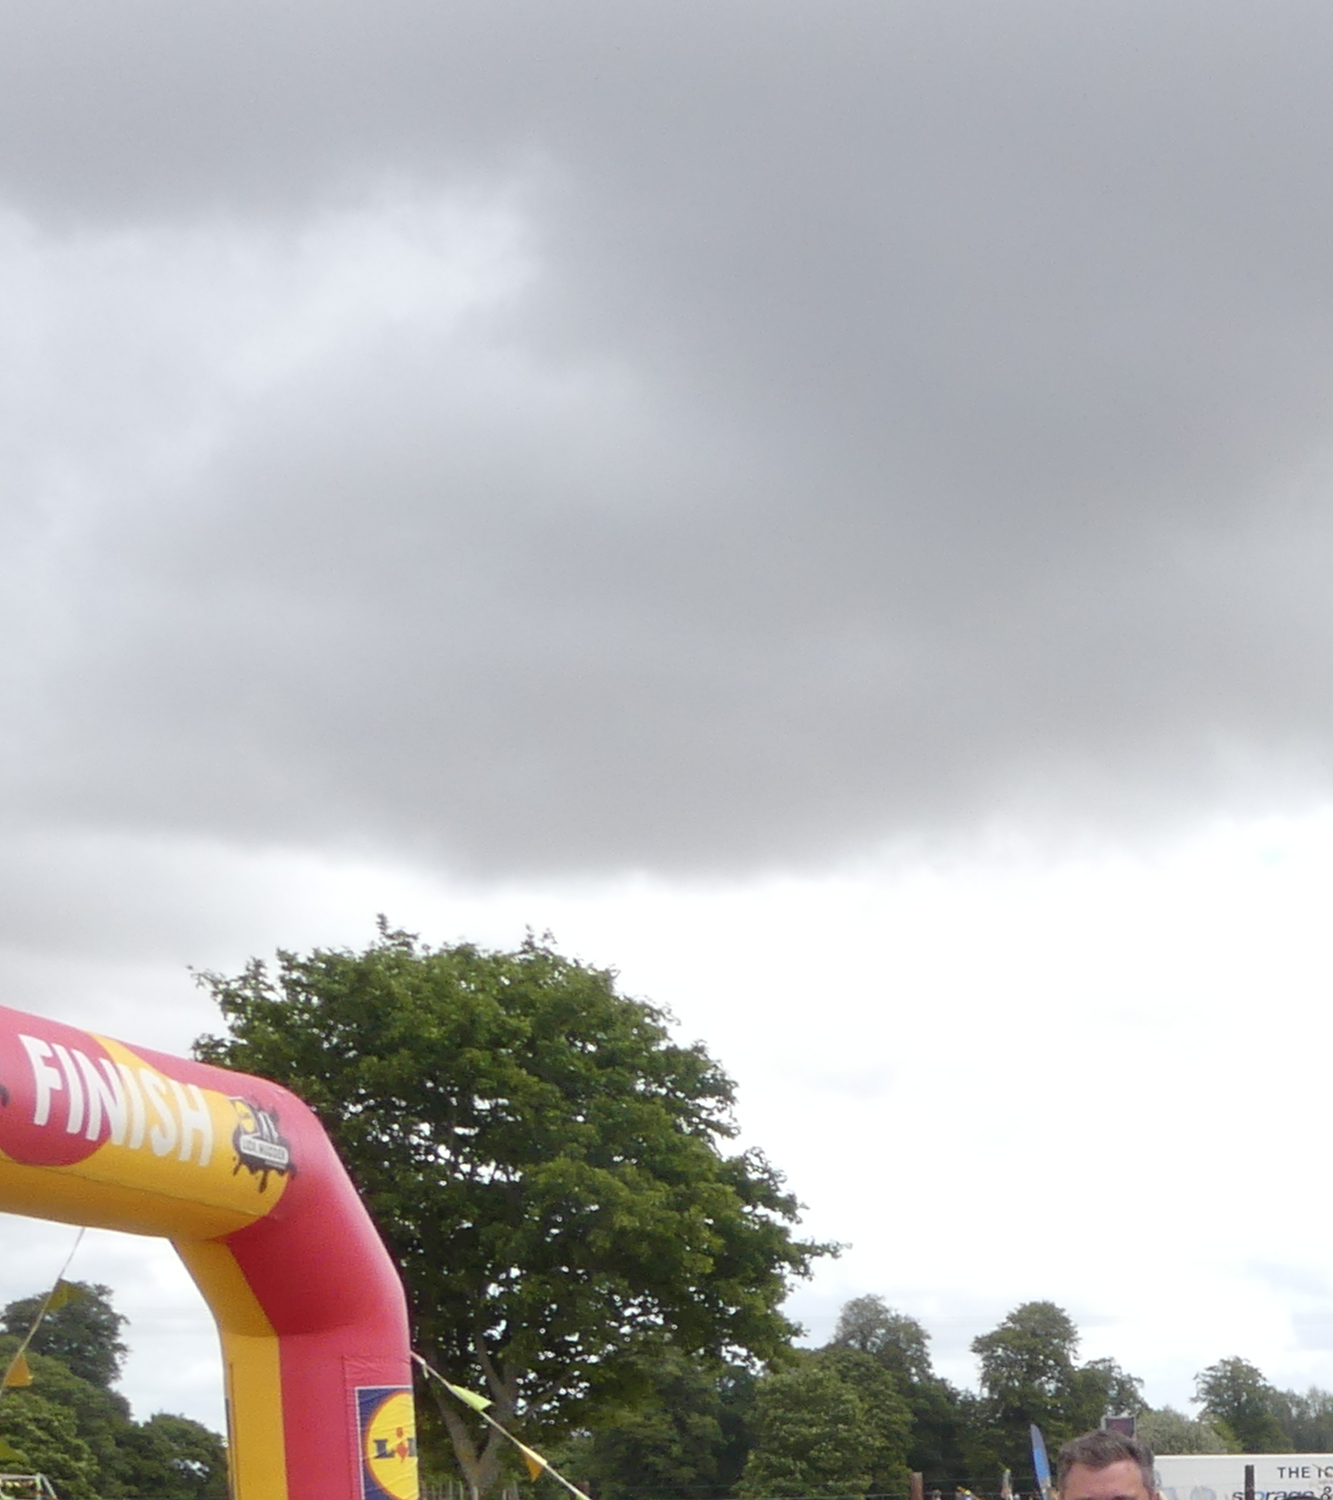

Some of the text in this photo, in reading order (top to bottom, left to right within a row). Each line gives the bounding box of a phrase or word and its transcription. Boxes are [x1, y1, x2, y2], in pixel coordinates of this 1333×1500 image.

[18, 1033, 214, 1168] FINISH
[1277, 1466, 1310, 1479] THE
[1320, 1486, 1333, 1500] &
